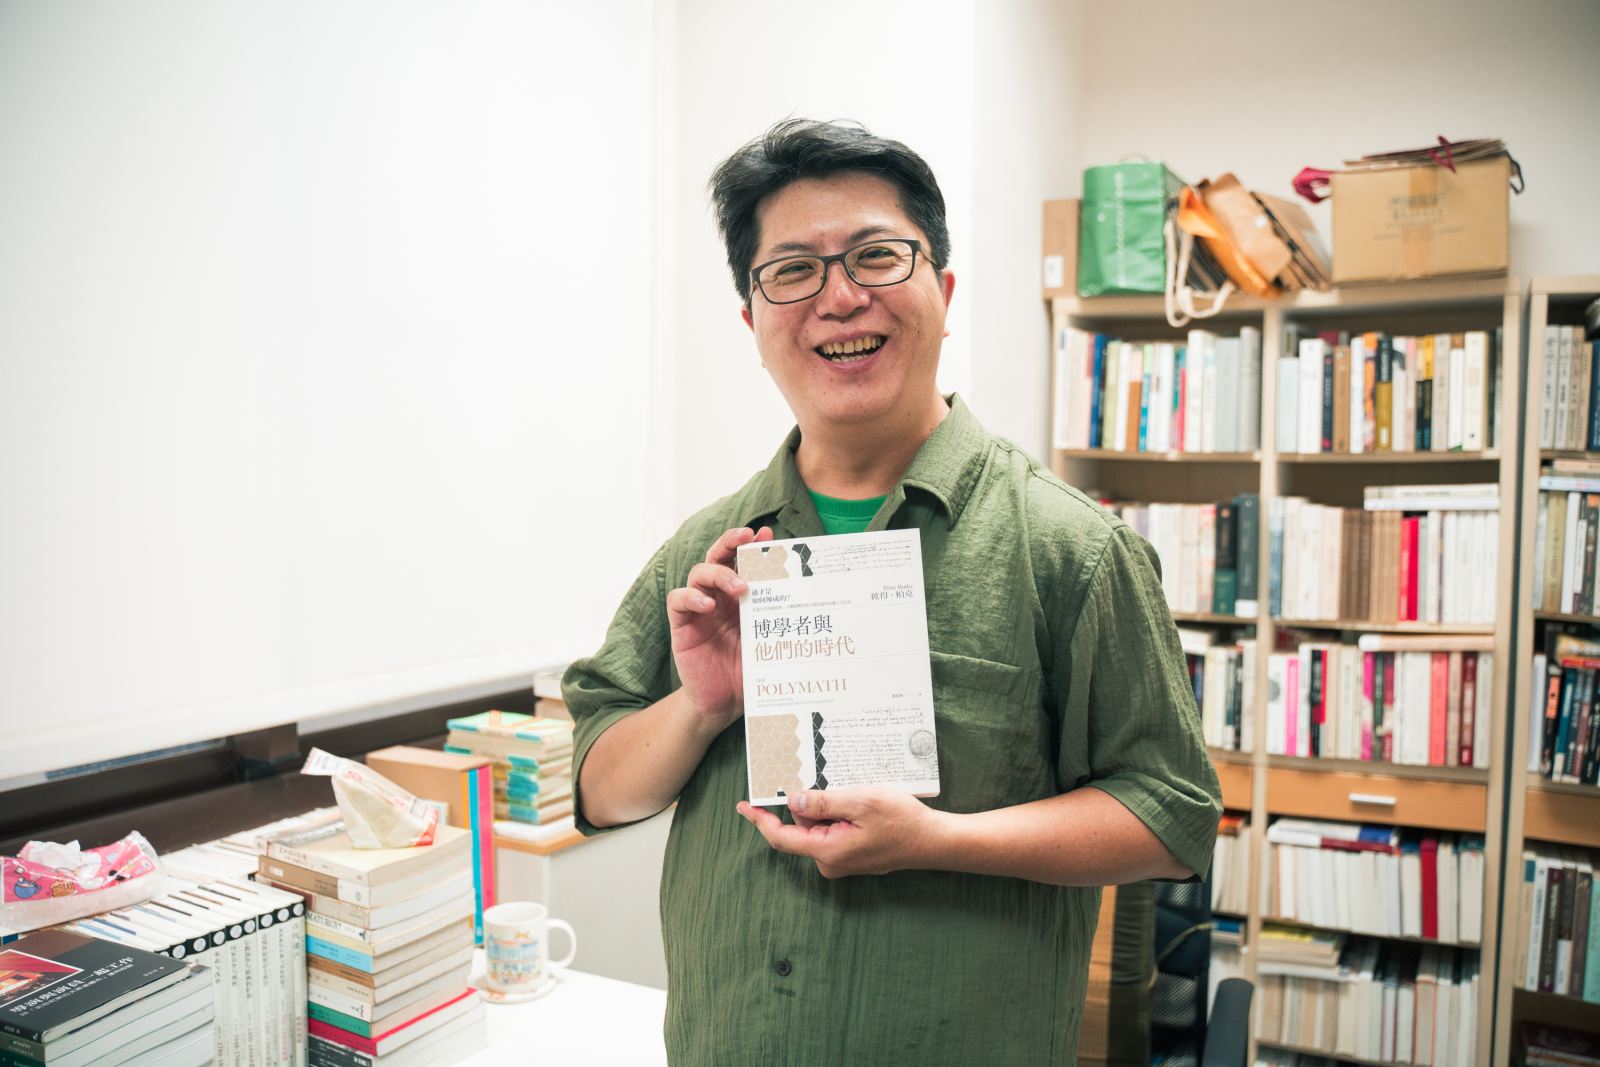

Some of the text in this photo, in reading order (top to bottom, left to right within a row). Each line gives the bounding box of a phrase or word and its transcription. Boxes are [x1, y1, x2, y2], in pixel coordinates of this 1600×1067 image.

[752, 614, 833, 640] 博學者與
[754, 635, 856, 662] 他們的時代
[757, 678, 848, 697] POLYMATH
